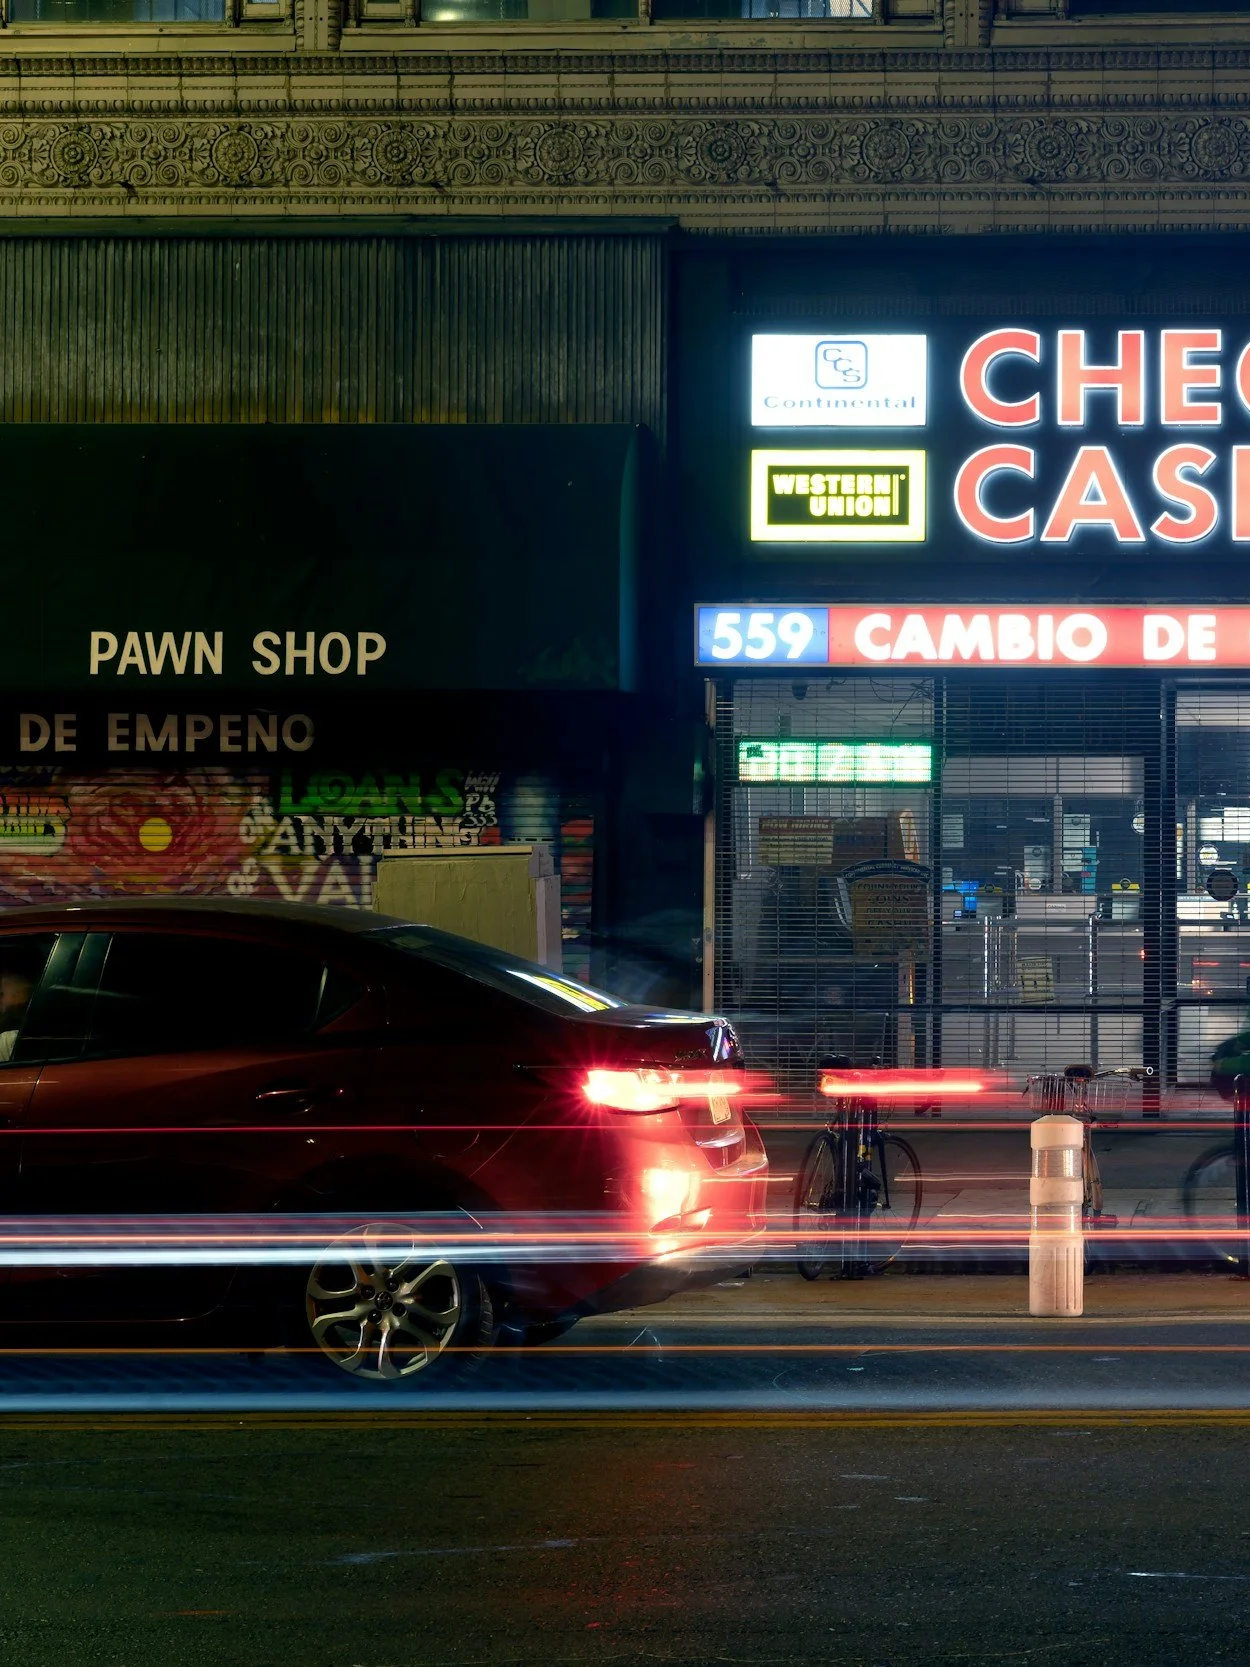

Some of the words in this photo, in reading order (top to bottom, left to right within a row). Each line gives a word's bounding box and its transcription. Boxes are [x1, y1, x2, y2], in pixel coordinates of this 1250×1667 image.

[763, 396, 915, 408] Continental
[772, 474, 891, 494] WESTERN
[809, 495, 891, 516] UNION
[89, 630, 224, 675] PAWN
[251, 630, 387, 676] SHOP
[710, 612, 814, 661] 559
[854, 612, 1108, 663] CAMBIO
[1143, 613, 1216, 661] DE
[19, 714, 77, 752] DE
[278, 767, 465, 816] LOANS
